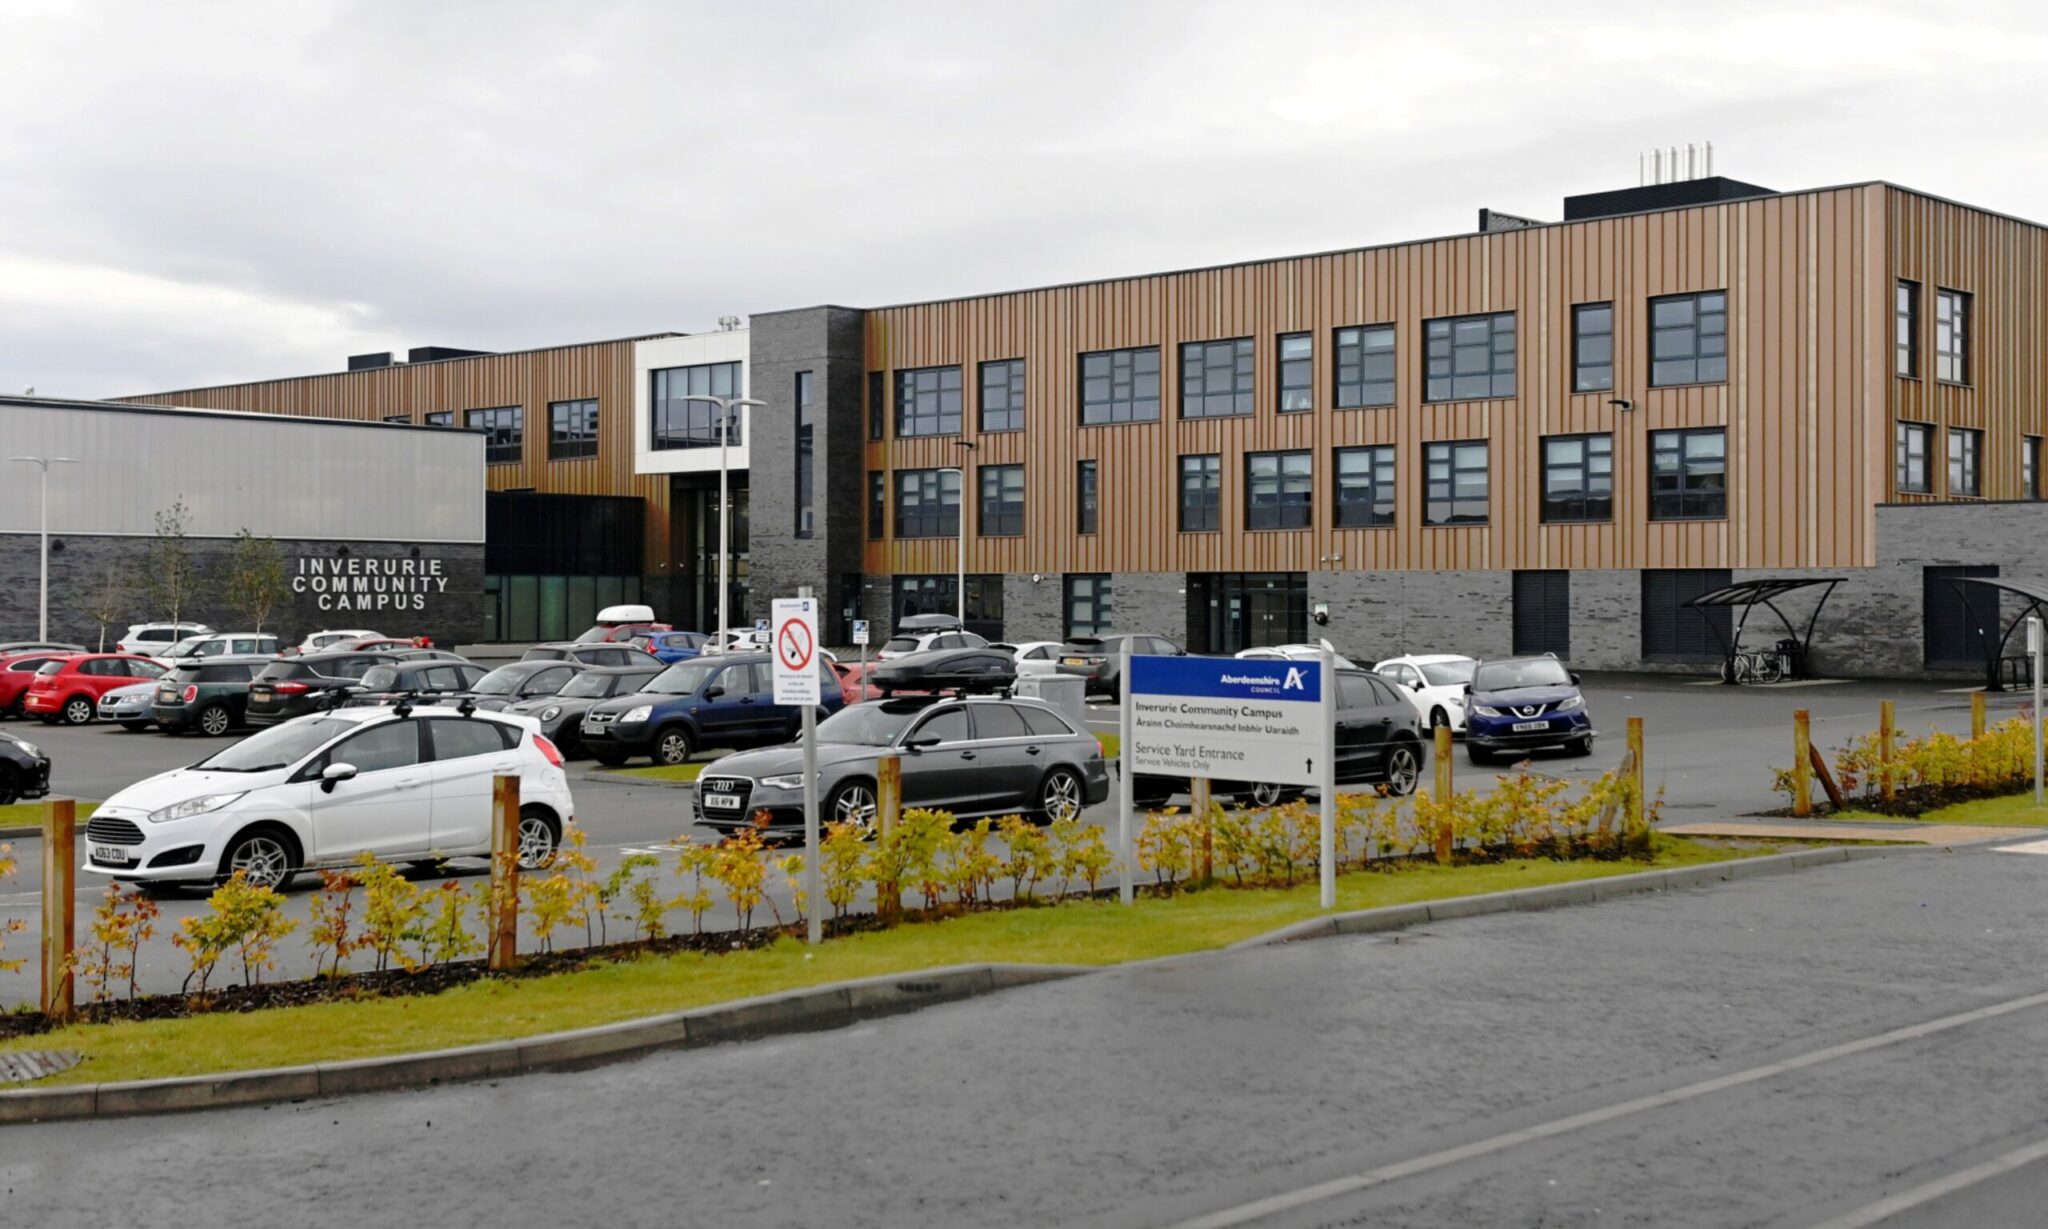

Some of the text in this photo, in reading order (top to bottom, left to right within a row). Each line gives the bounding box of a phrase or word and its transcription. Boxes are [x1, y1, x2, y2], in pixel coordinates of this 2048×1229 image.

[300, 558, 442, 575] INVERURIE
[292, 576, 448, 593] COMMUNITY
[318, 594, 425, 610] CAMPUS
[1221, 674, 1280, 686] Aberdeenshire
[1135, 701, 1283, 720] Inverurie Community Campus
[1164, 719, 1236, 732] Choimhearsnachd
[1238, 723, 1262, 733] Inbhir
[1265, 725, 1299, 736] Uaraidh
[1135, 741, 1245, 760] Service Yard Entrance
[1135, 756, 1210, 772] Service Vehicles Only
